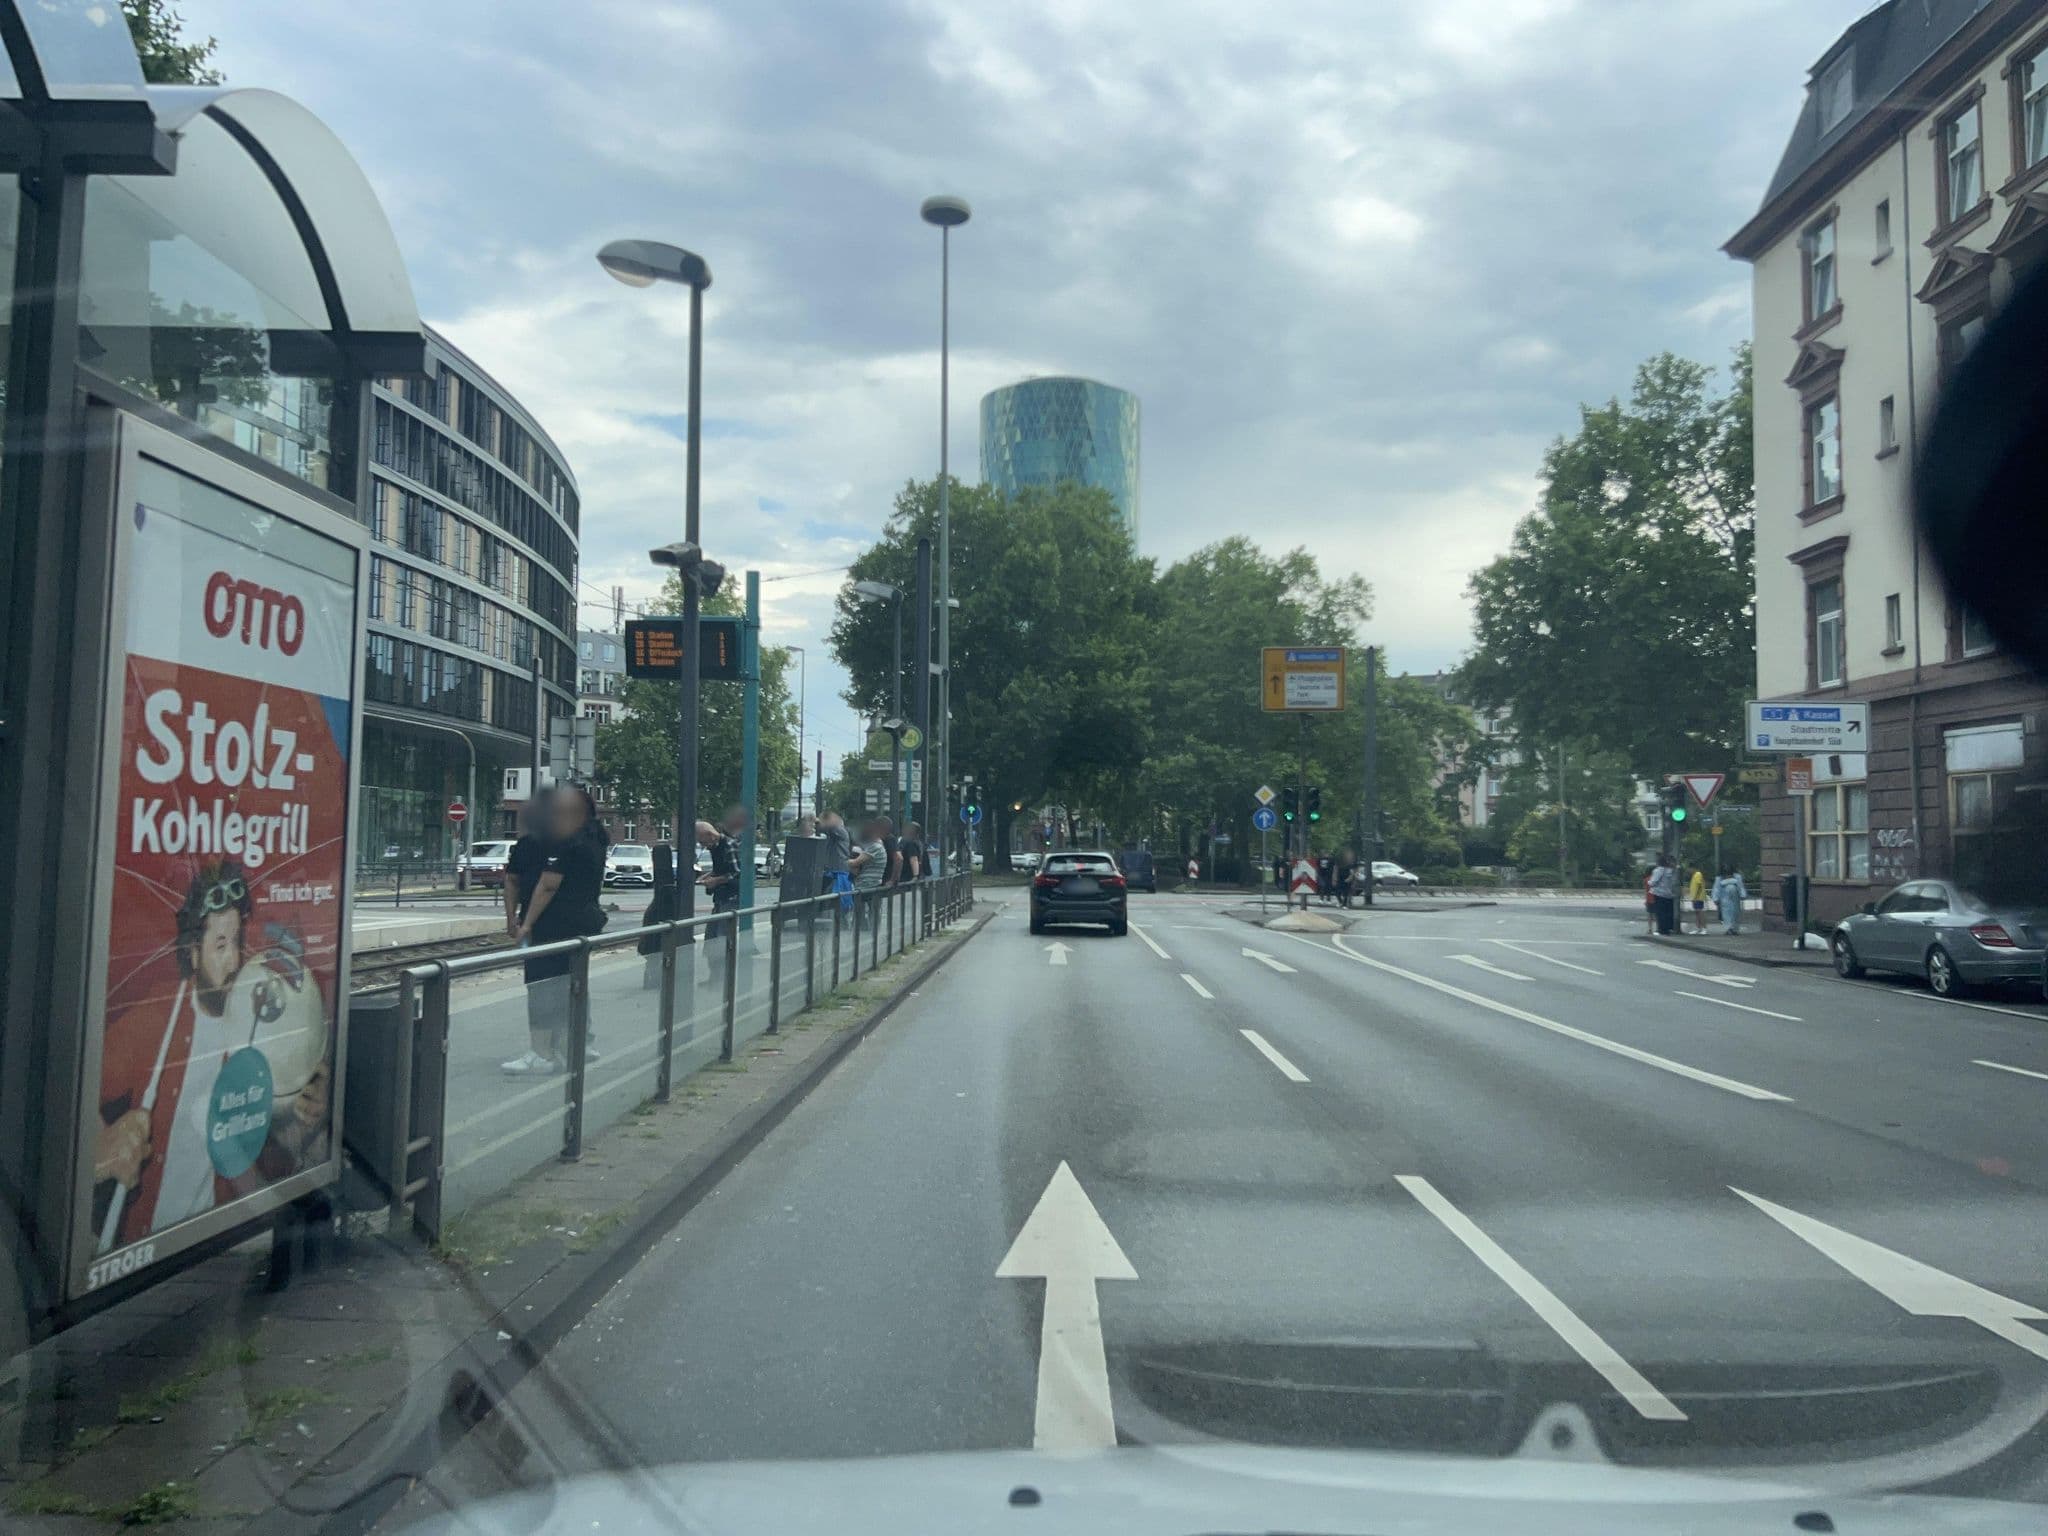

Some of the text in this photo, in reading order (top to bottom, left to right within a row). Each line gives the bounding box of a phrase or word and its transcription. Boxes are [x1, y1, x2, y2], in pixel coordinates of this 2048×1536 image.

[204, 570, 305, 657] OTTO
[136, 688, 315, 790] Stolz-
[131, 796, 309, 868] Kohlegrill
[219, 1090, 247, 1113] Alles
